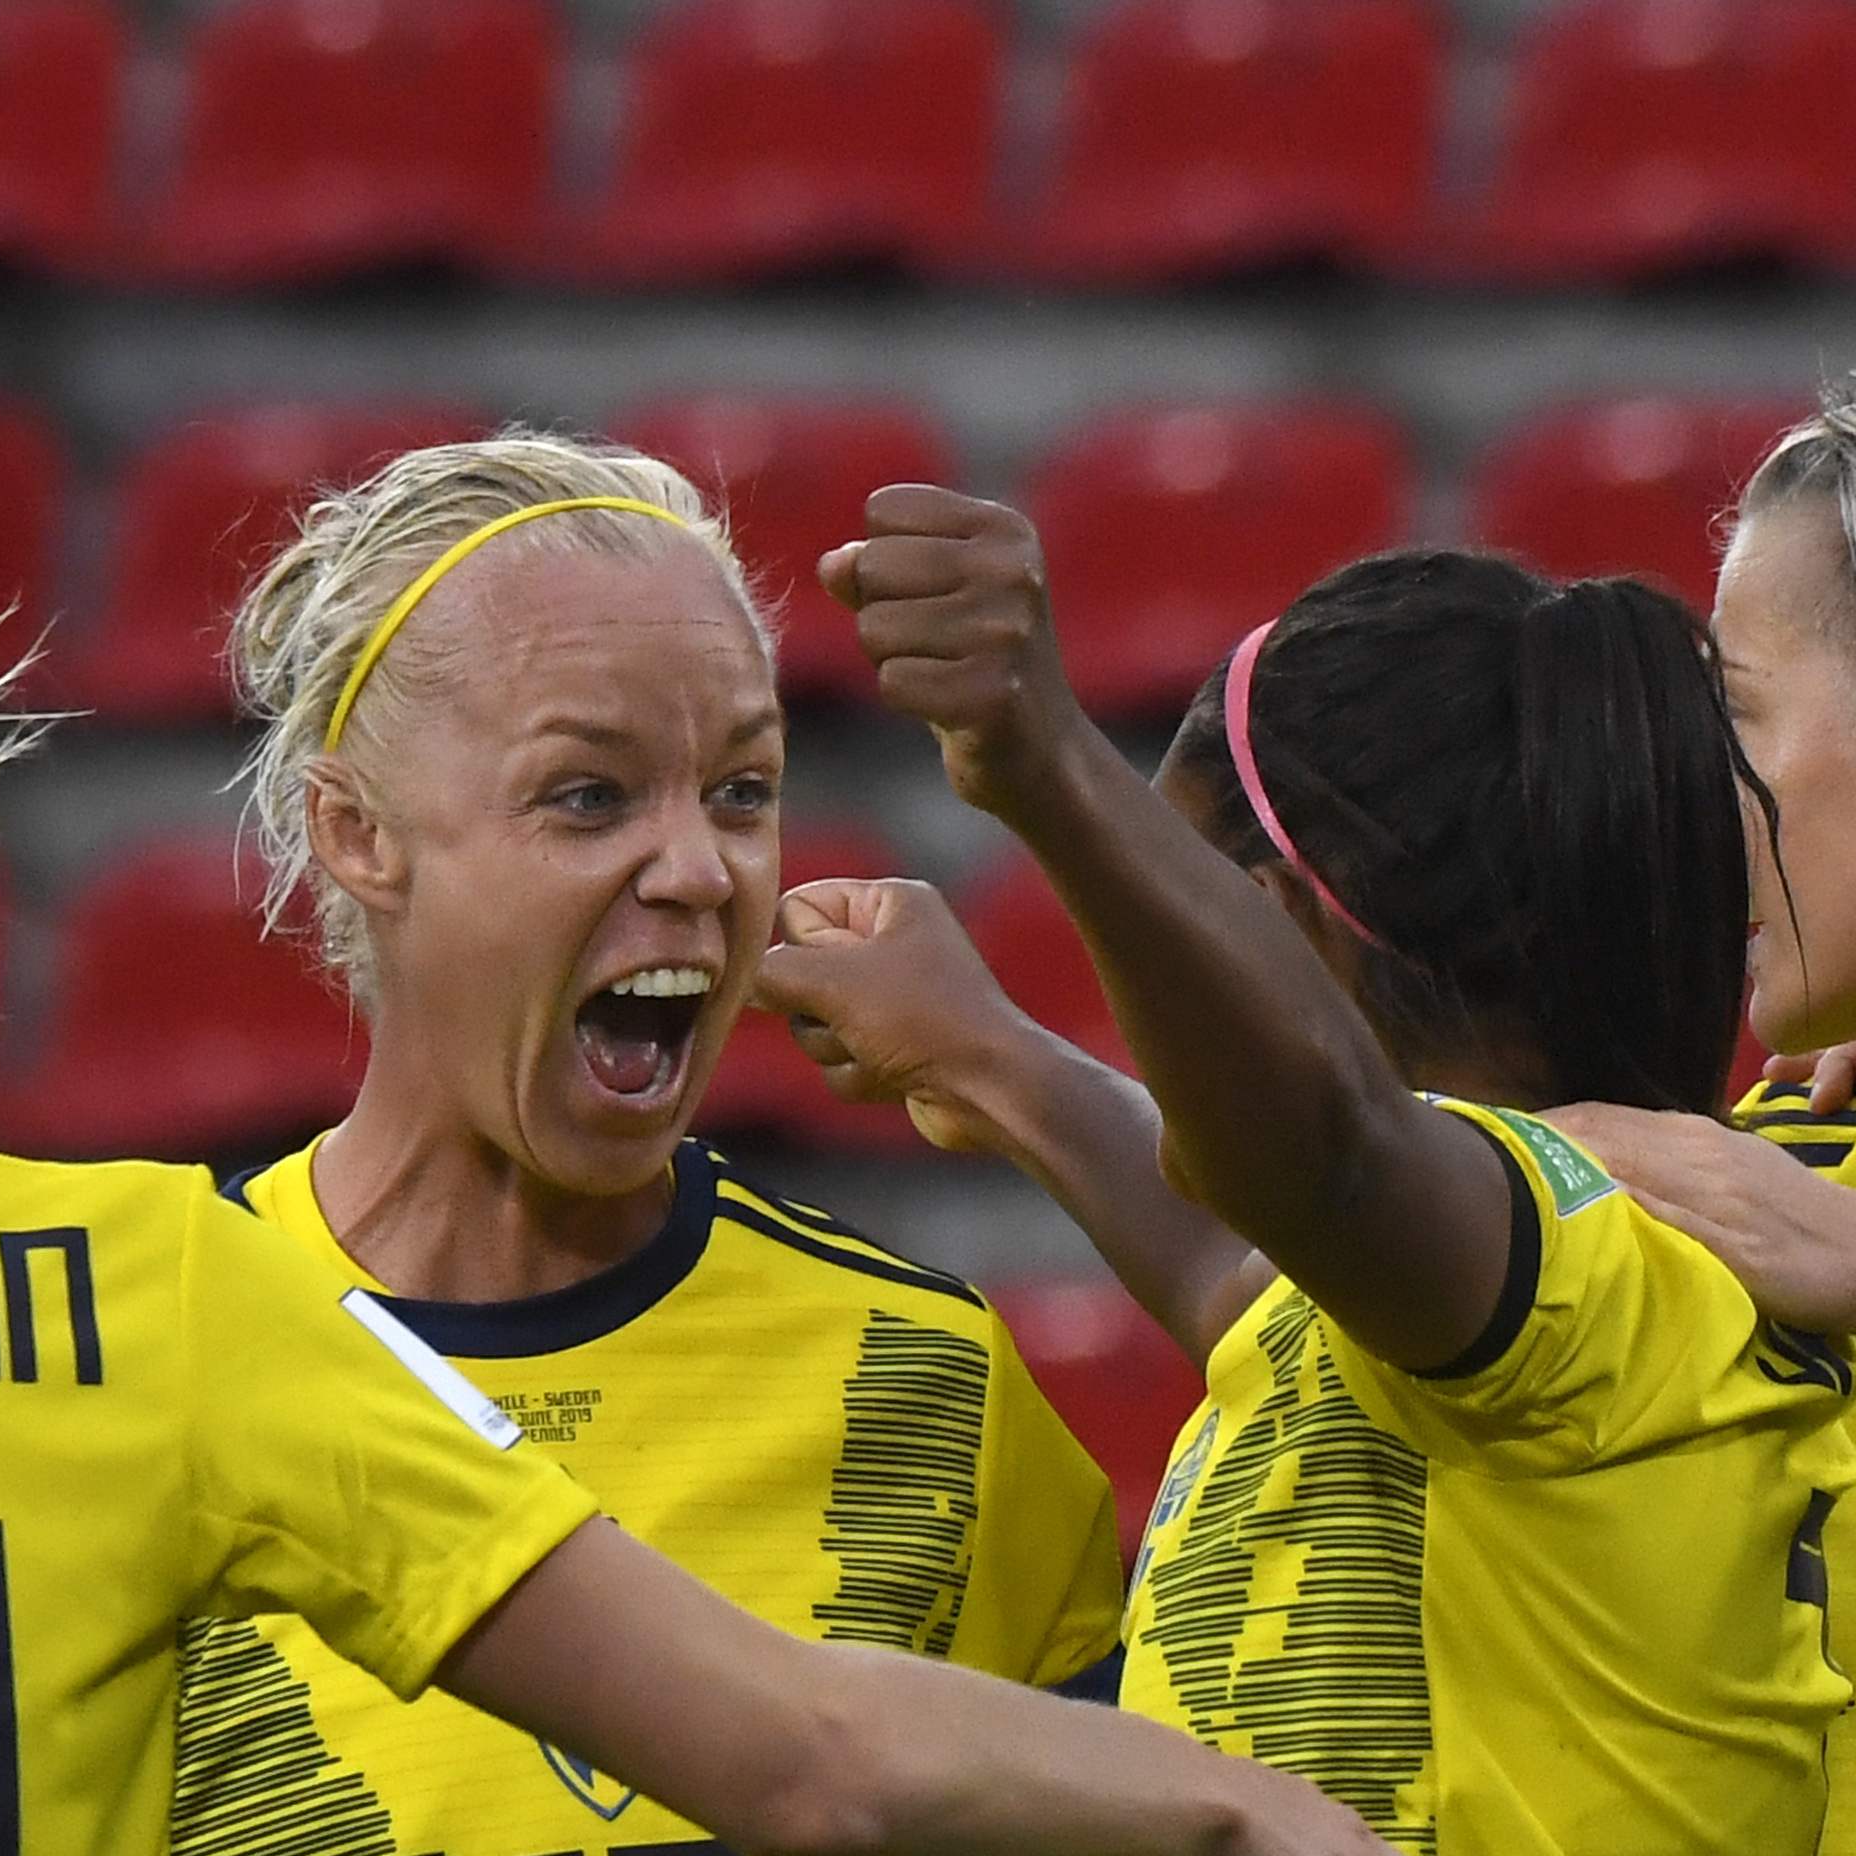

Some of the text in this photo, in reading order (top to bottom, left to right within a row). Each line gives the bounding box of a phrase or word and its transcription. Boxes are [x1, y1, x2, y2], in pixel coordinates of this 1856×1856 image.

[488, 1394, 528, 1411] HILE
[544, 1389, 603, 1408] SWEDEN
[517, 1410, 556, 1427] JUNE
[559, 1408, 593, 1424] 2019
